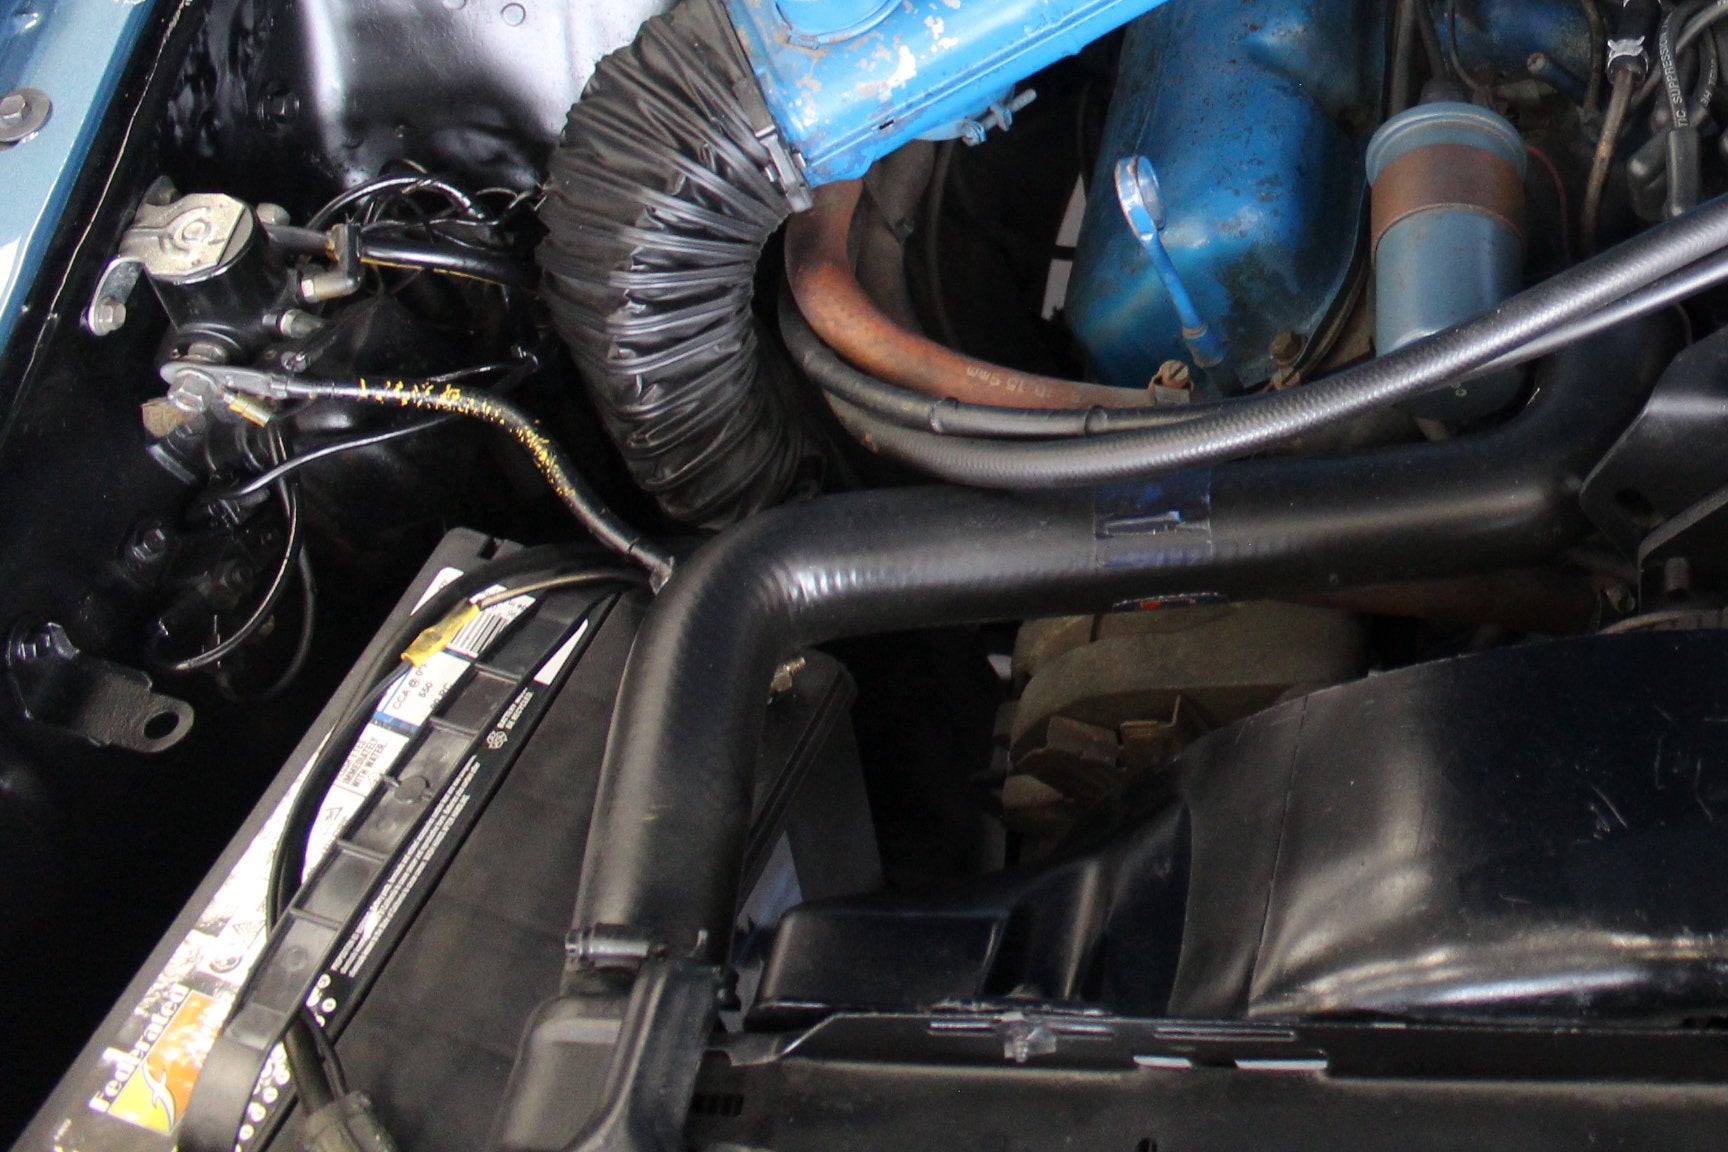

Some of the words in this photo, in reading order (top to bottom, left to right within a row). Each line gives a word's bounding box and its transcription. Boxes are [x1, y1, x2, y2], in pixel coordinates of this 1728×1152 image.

[1659, 31, 1683, 105] SUPPRESSION
[392, 689, 411, 710] CCA
[342, 736, 381, 784] IMMEDIATELY
[88, 982, 192, 1113] Federated
